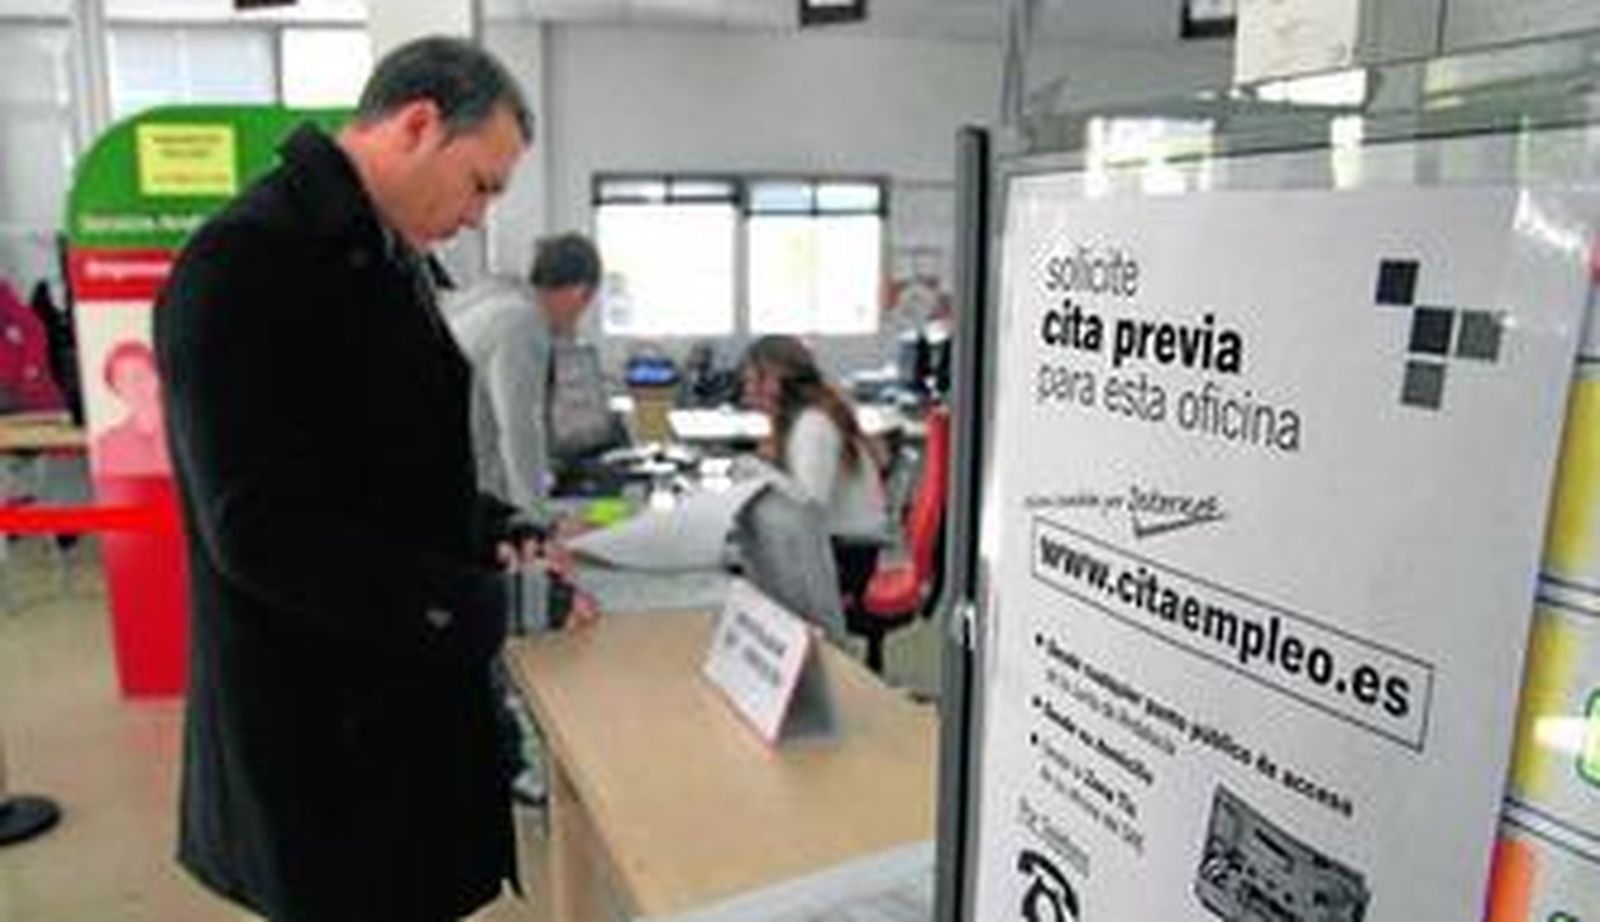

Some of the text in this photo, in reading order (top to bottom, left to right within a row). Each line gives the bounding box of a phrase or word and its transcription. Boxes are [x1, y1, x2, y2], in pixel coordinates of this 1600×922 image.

[1045, 248, 1139, 298] solicite
[1040, 299, 1243, 374] cita previa
[1035, 361, 1302, 452] para esta oficina
[1039, 535, 1412, 720] www.citaempleo.es
